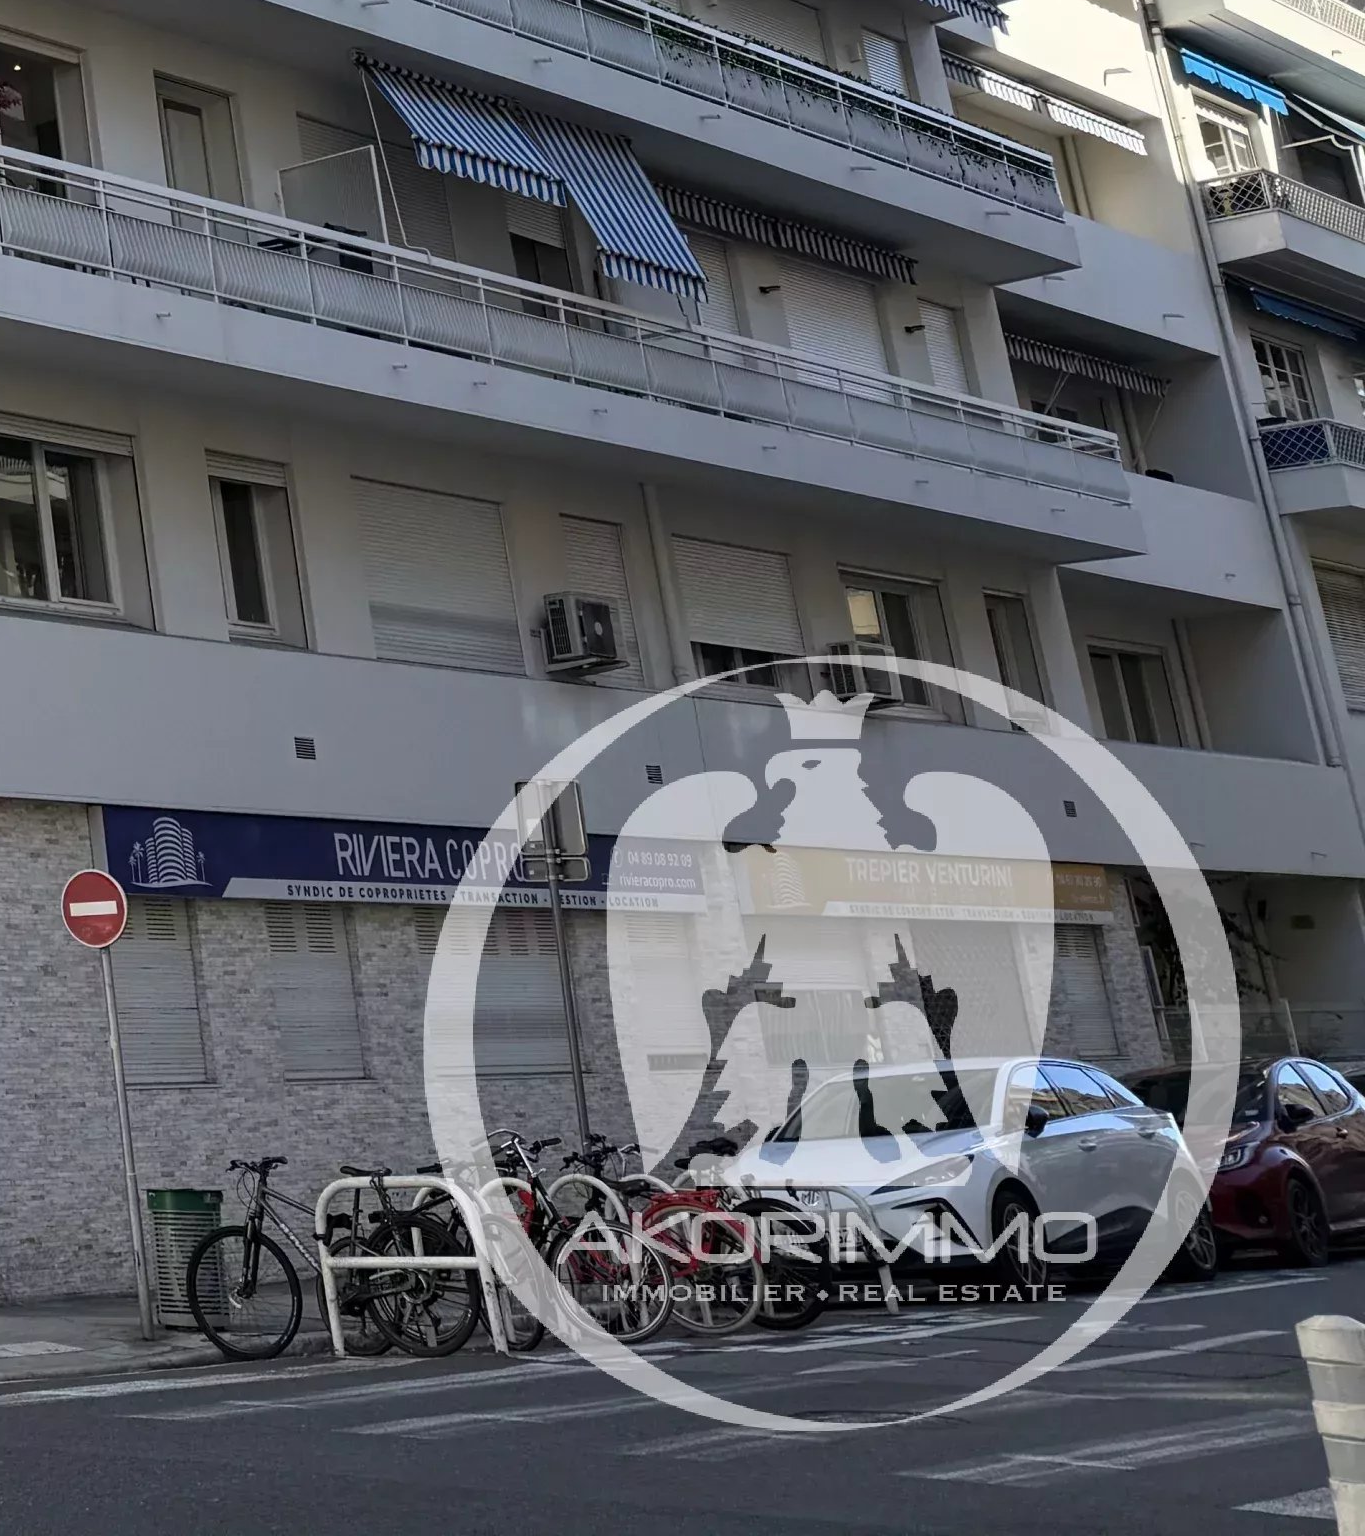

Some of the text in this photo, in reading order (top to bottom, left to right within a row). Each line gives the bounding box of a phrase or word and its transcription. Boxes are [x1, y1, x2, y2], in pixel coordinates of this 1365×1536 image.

[333, 832, 445, 880] RIVIERA
[619, 872, 697, 891] rivieracopro.com
[925, 862, 1014, 888] VENTURINI
[287, 884, 660, 908] SYNDIC DE COPROPRIETES TRANSACTION ESTION LOCATION
